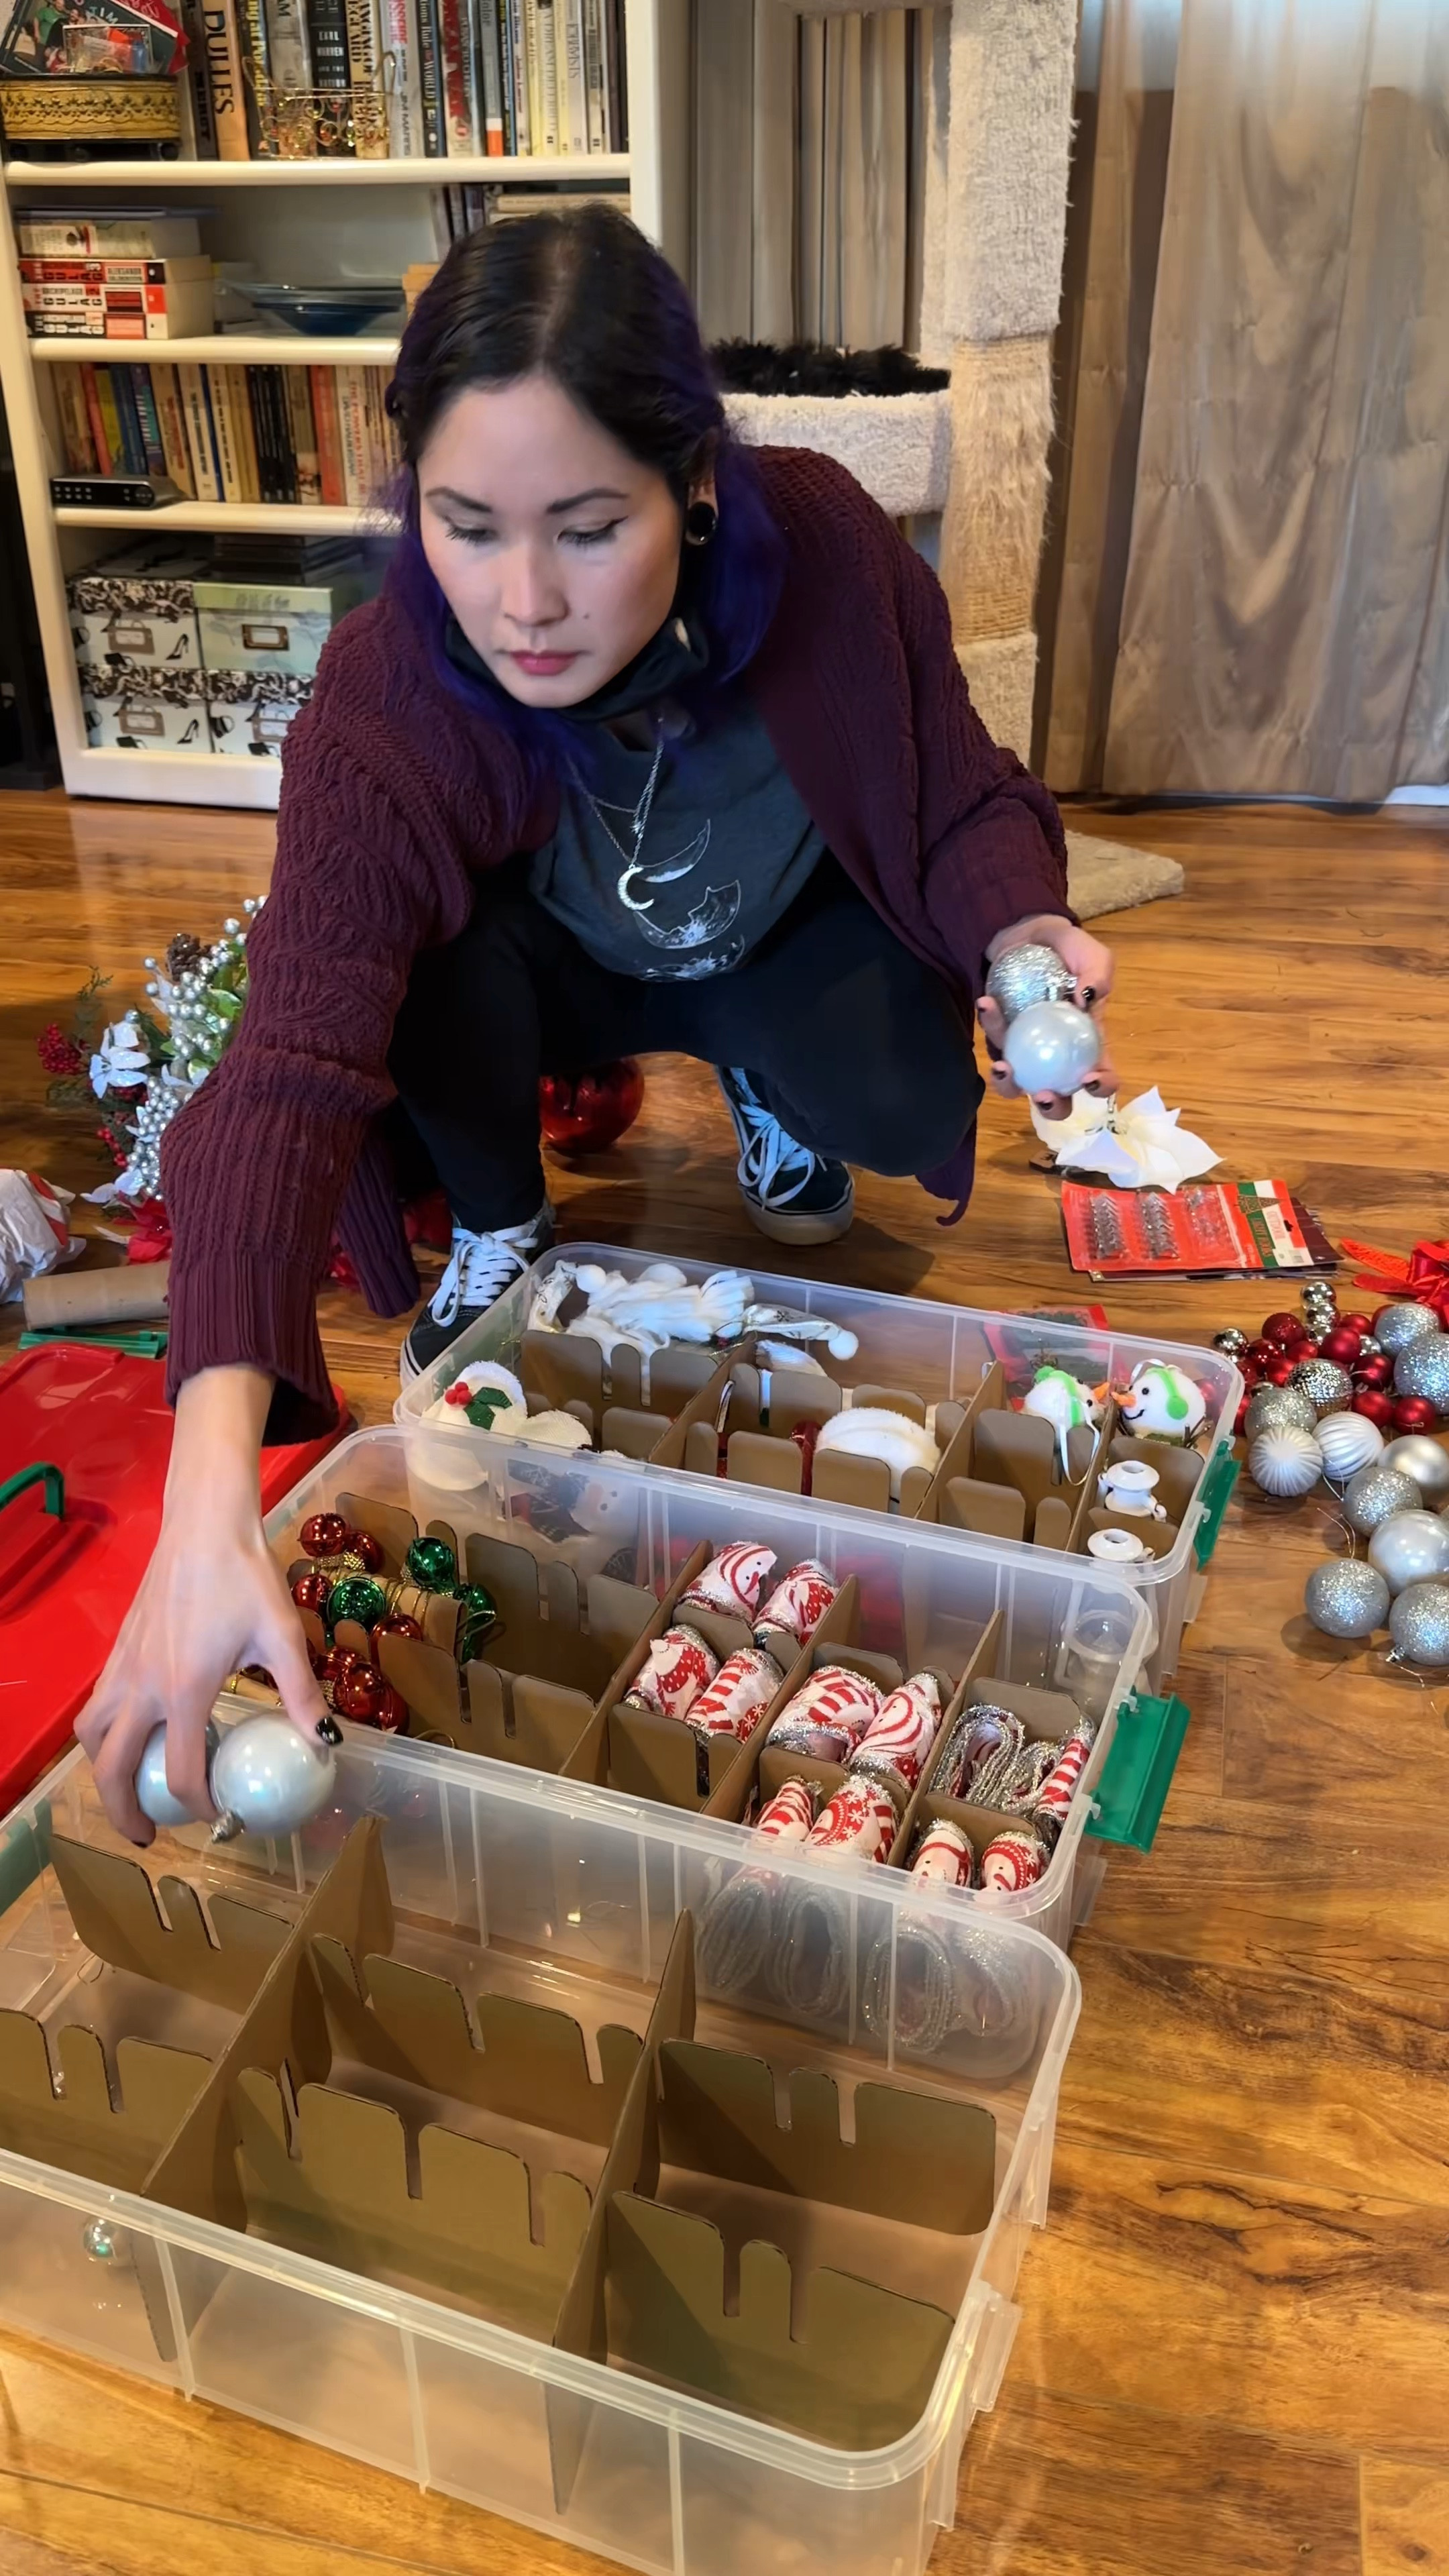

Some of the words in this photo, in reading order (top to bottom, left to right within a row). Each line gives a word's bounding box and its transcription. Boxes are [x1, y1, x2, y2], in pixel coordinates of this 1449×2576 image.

[319, 31, 339, 41] EARL
[359, 1, 371, 56] ANGING
[421, 26, 432, 49] Rule
[204, 11, 233, 114] DULLES
[317, 47, 344, 56] WARREN
[423, 61, 435, 99] WORLD
[43, 272, 103, 280] GULAG
[44, 324, 104, 334] GULAG
[352, 402, 363, 449] POWERS
[357, 453, 365, 482] THAT
